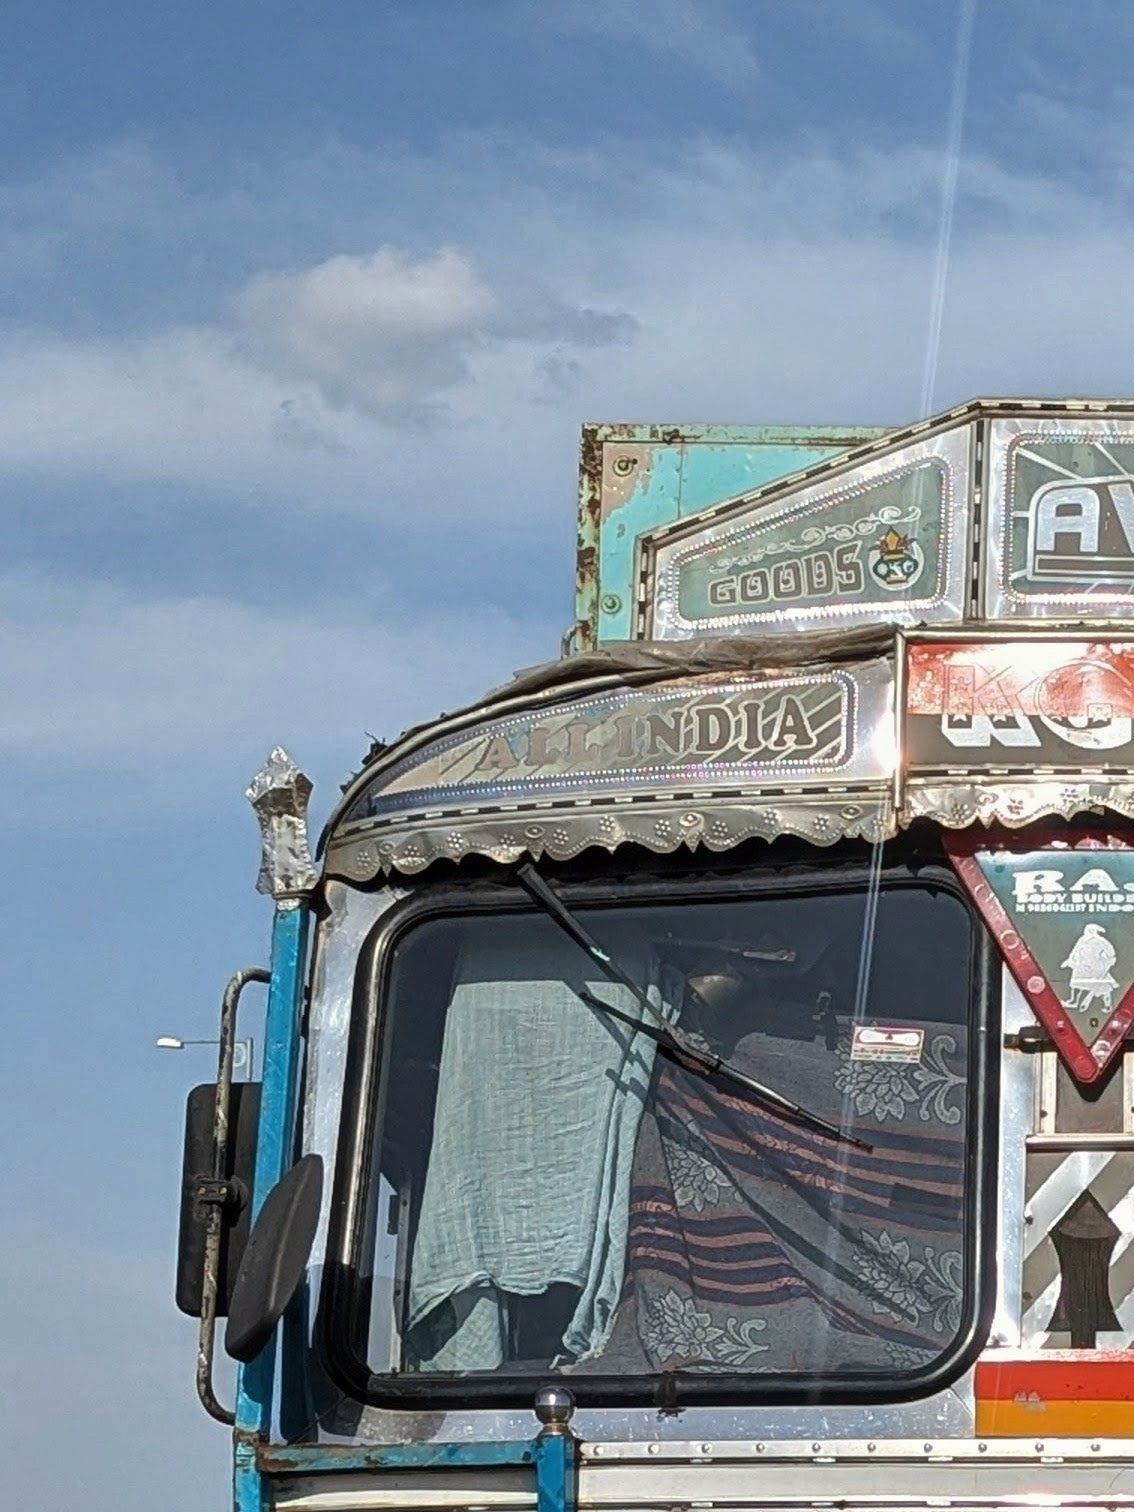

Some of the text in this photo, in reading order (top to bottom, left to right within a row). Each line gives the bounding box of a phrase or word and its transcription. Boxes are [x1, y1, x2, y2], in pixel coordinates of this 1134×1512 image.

[708, 540, 865, 607] GOODS
[477, 694, 817, 771] ALL INDIA
[1016, 893, 1066, 903] BODY
